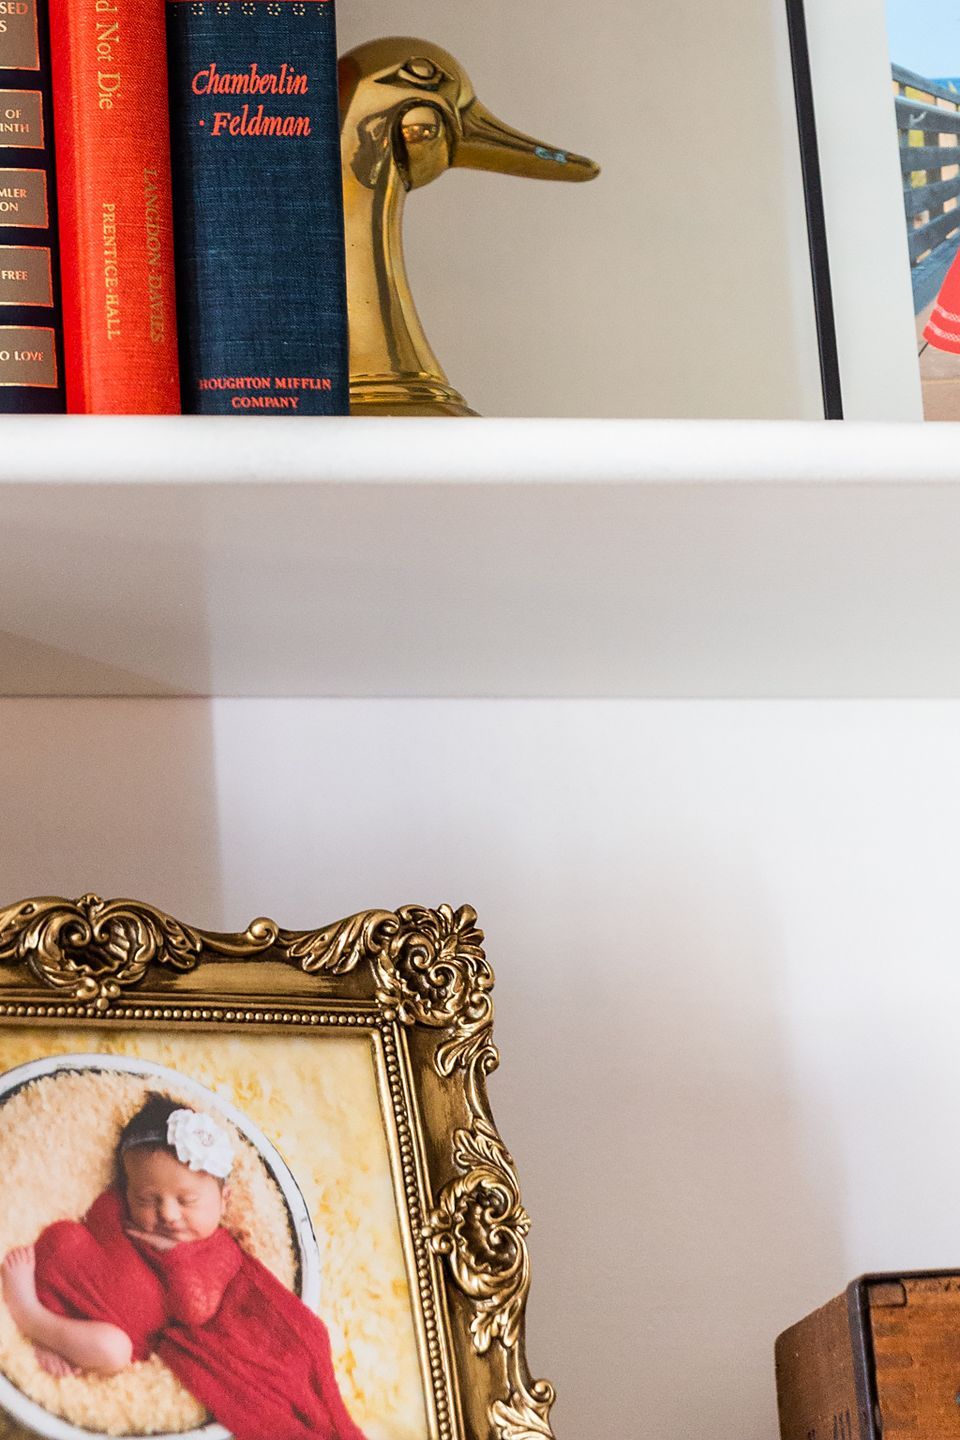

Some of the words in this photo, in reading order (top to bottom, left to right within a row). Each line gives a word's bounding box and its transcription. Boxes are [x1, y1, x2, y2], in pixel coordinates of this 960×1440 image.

[95, 22, 119, 62] Not
[191, 63, 308, 95] Chamberlin
[97, 71, 121, 110] Die
[5, 109, 22, 119] OF
[210, 104, 311, 136] Feldman
[1, 270, 29, 281] FREE
[14, 351, 44, 361] LOVE
[199, 376, 271, 390] HOUGHTON
[275, 377, 332, 390] MIFFLIN
[231, 396, 300, 408] COMPANY
